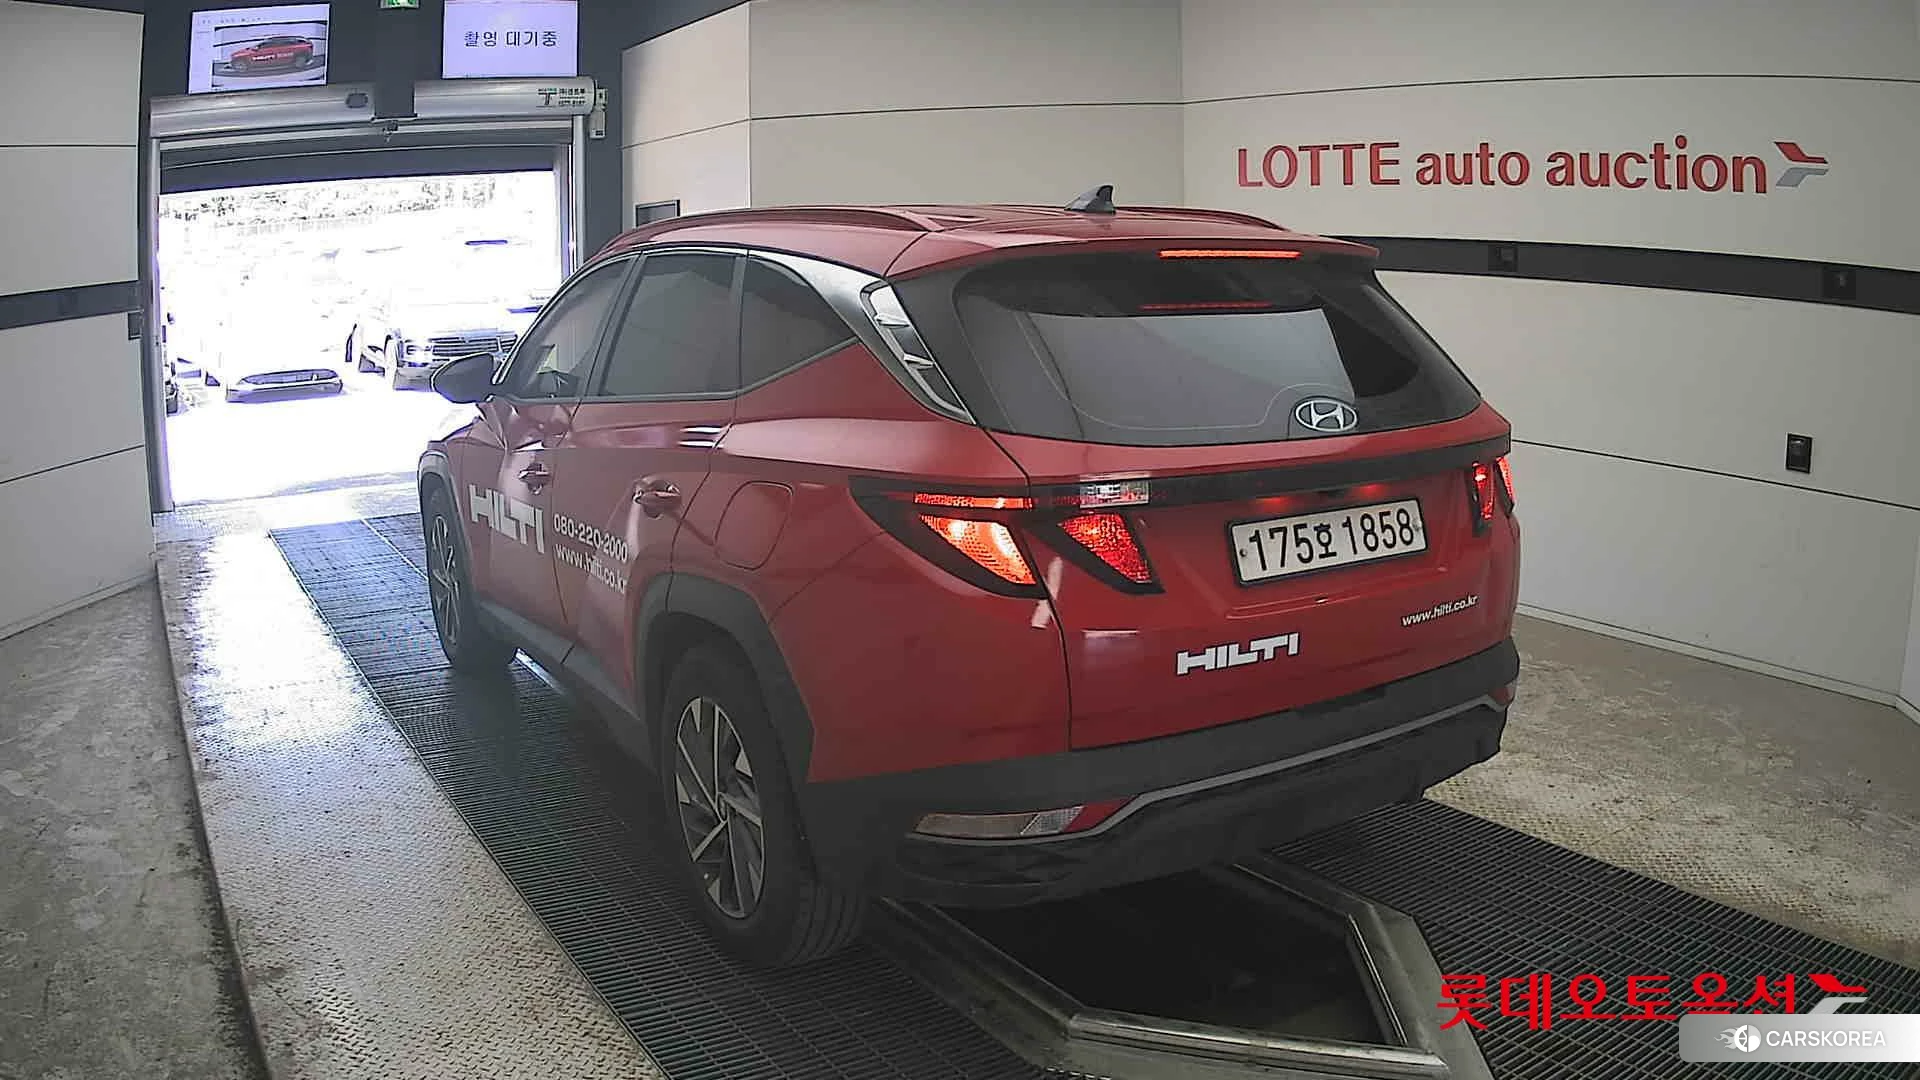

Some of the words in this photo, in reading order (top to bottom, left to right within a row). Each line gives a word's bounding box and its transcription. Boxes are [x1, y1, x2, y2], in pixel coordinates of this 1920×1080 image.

[506, 30, 557, 47] 대기중
[1238, 142, 1400, 188] LOTTE
[1415, 143, 1531, 186] auto
[1545, 135, 1768, 194] auction
[468, 484, 545, 554] HILTI
[1249, 523, 1337, 571] 175호
[1342, 508, 1414, 555] 1858
[555, 544, 627, 594] www.hilti.co.kr
[1402, 595, 1477, 626] www.hilti.co.kr
[1177, 632, 1299, 675] HILTI
